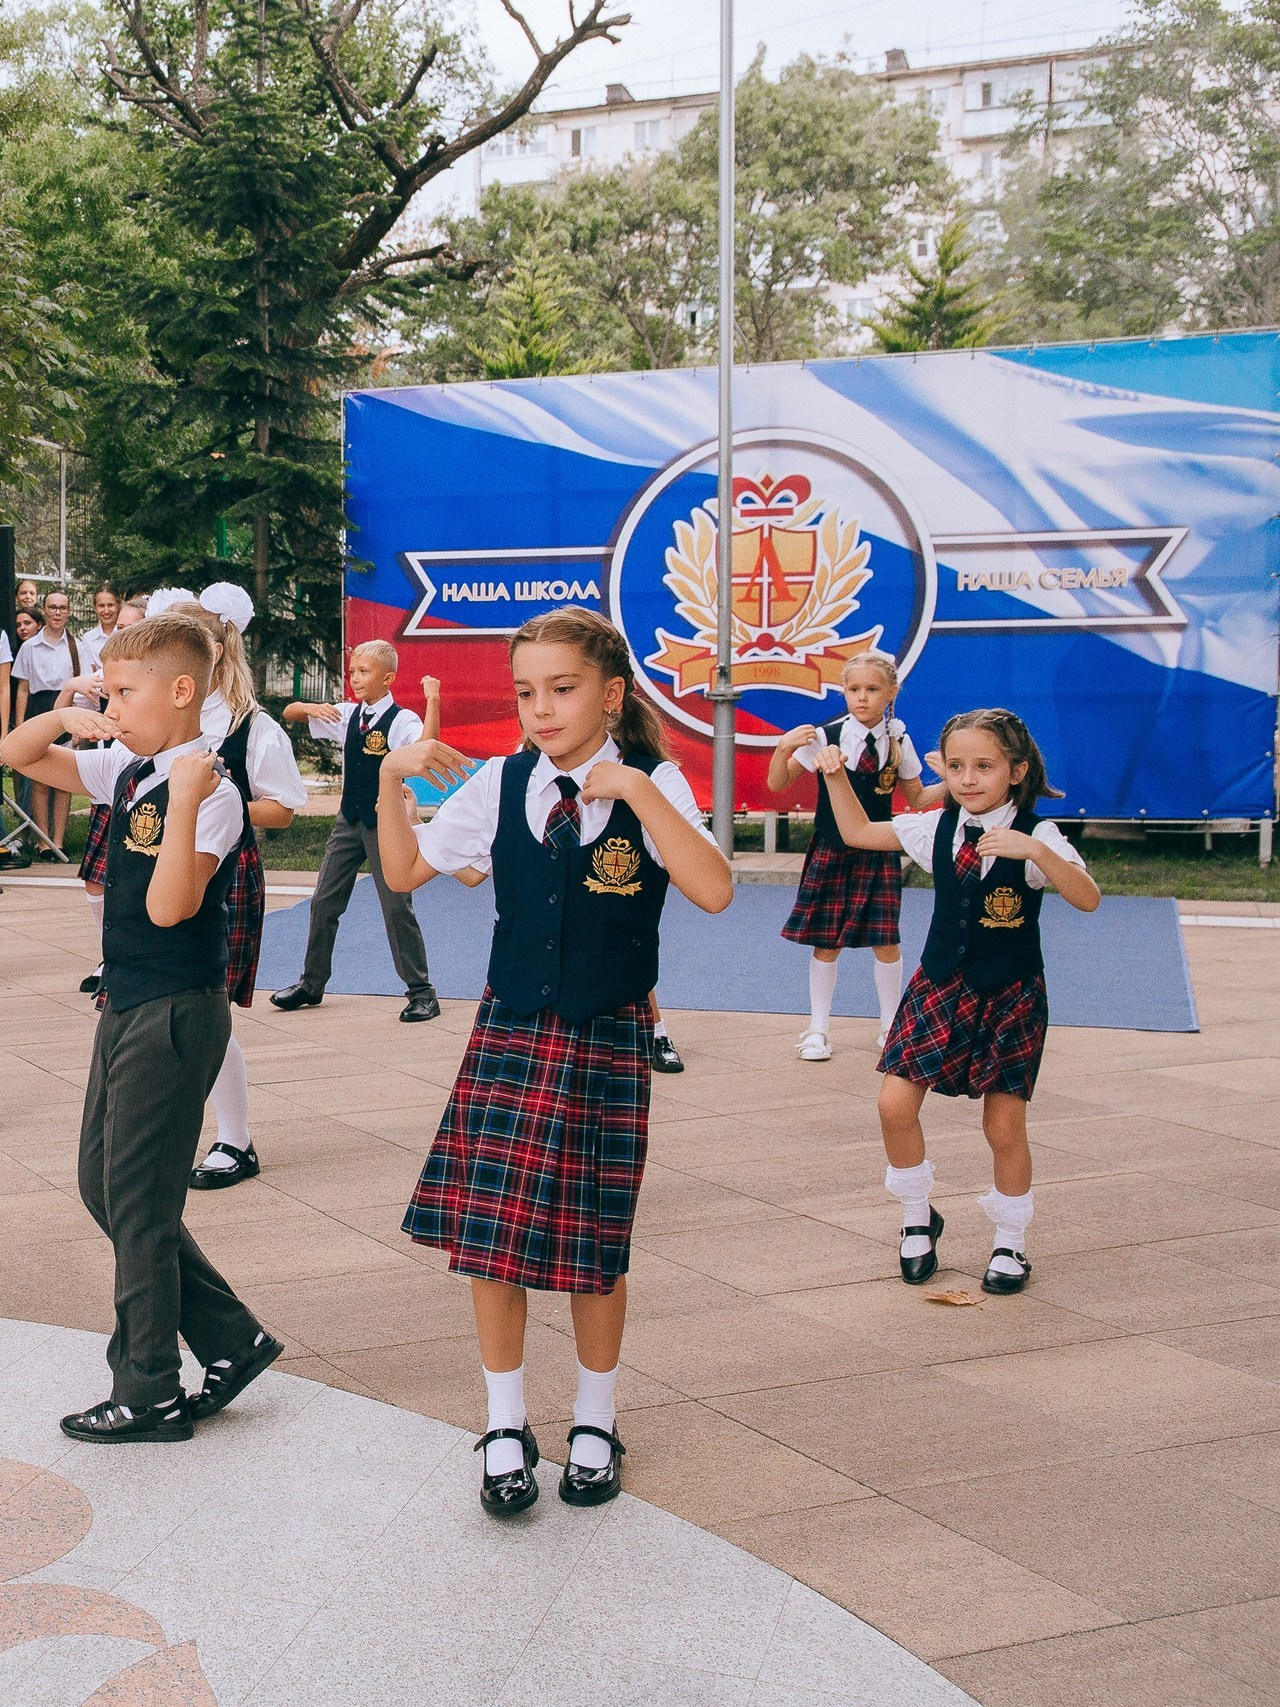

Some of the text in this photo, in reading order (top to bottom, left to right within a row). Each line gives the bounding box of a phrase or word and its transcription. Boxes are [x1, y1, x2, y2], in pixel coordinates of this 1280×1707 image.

[442, 579, 601, 602] НАША ШКОЛА
[957, 566, 1129, 592] НАША СЕМЬЯ
